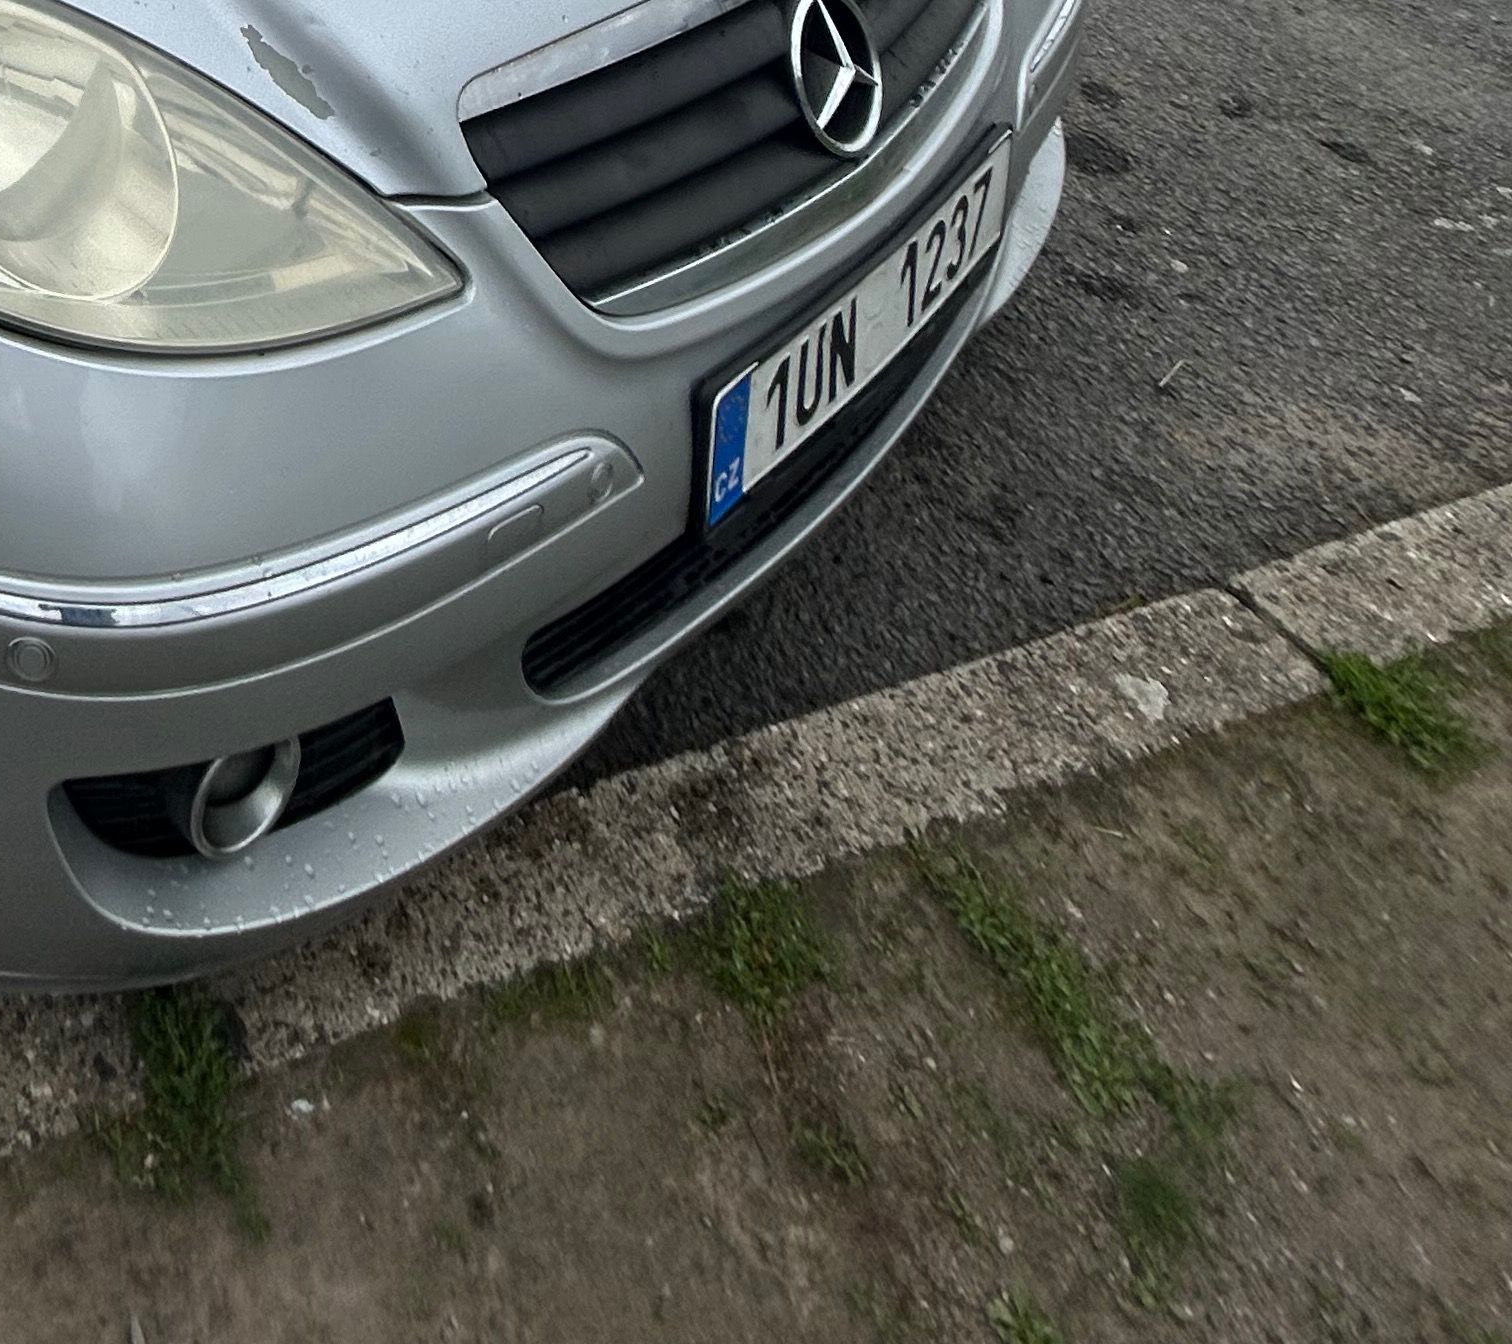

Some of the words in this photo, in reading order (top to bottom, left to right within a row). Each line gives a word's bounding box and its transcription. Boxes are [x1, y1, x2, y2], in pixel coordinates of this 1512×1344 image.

[766, 297, 857, 451] 1UN
[899, 166, 993, 328] 1237
[714, 456, 740, 503] CZ
